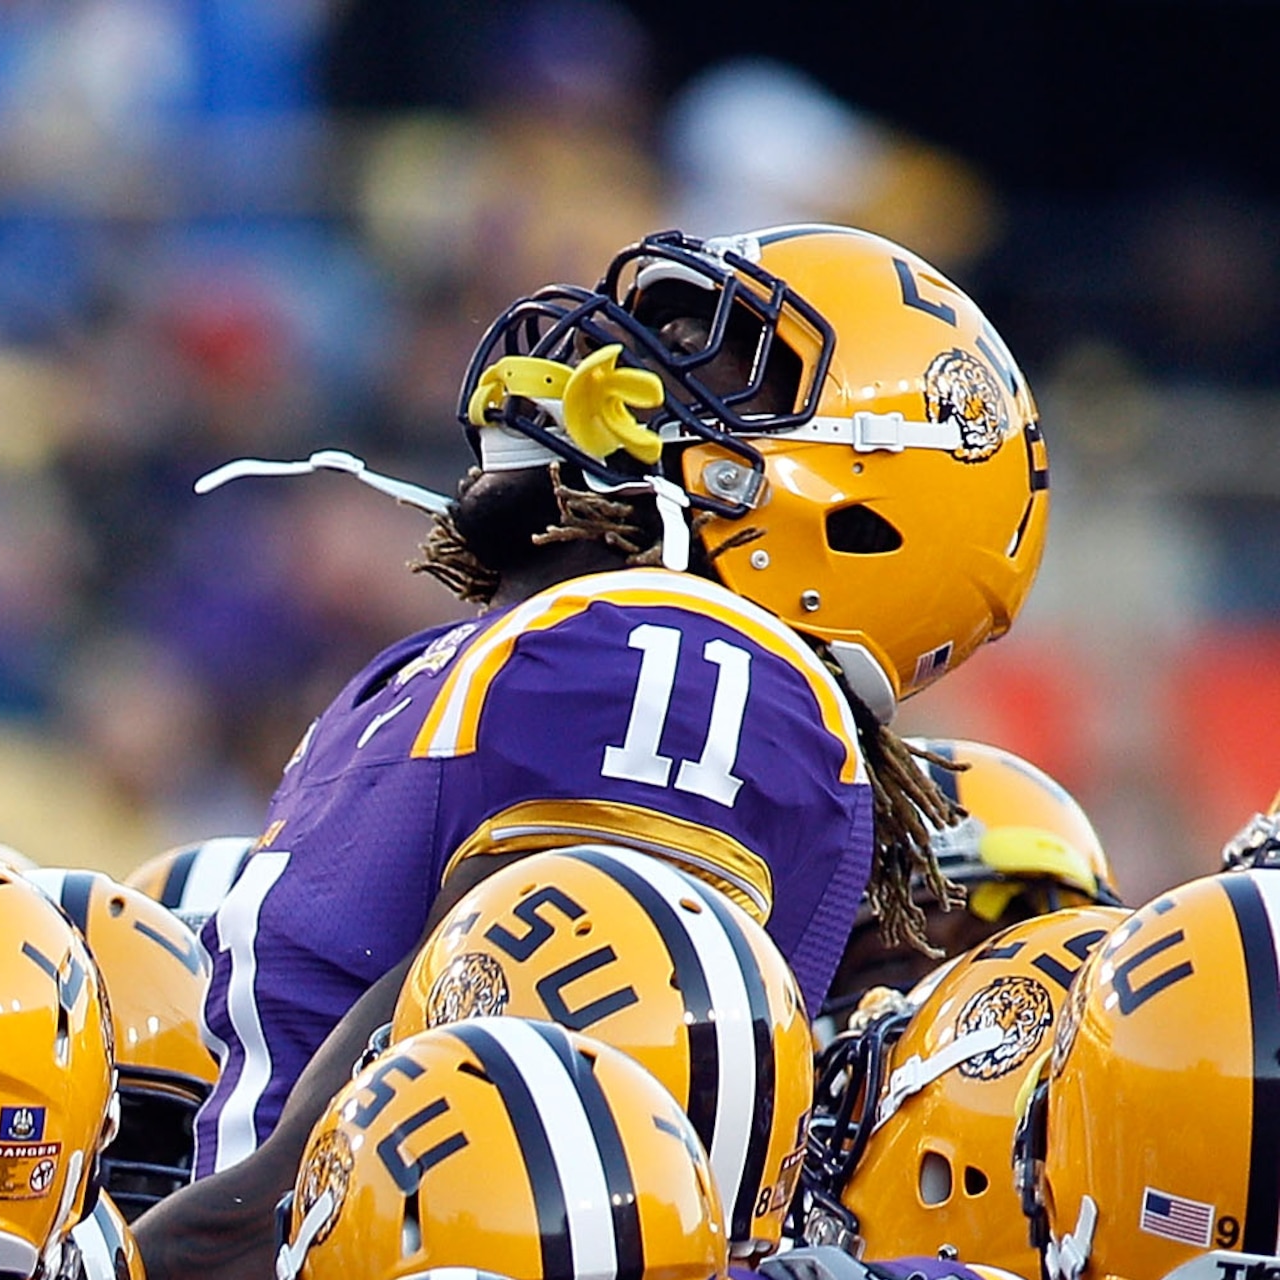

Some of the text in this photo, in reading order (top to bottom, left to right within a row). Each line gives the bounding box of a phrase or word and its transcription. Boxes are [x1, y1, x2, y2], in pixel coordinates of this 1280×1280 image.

[601, 623, 754, 808] 11
[755, 1187, 772, 1219] 8
[1215, 1216, 1240, 1248] 9
